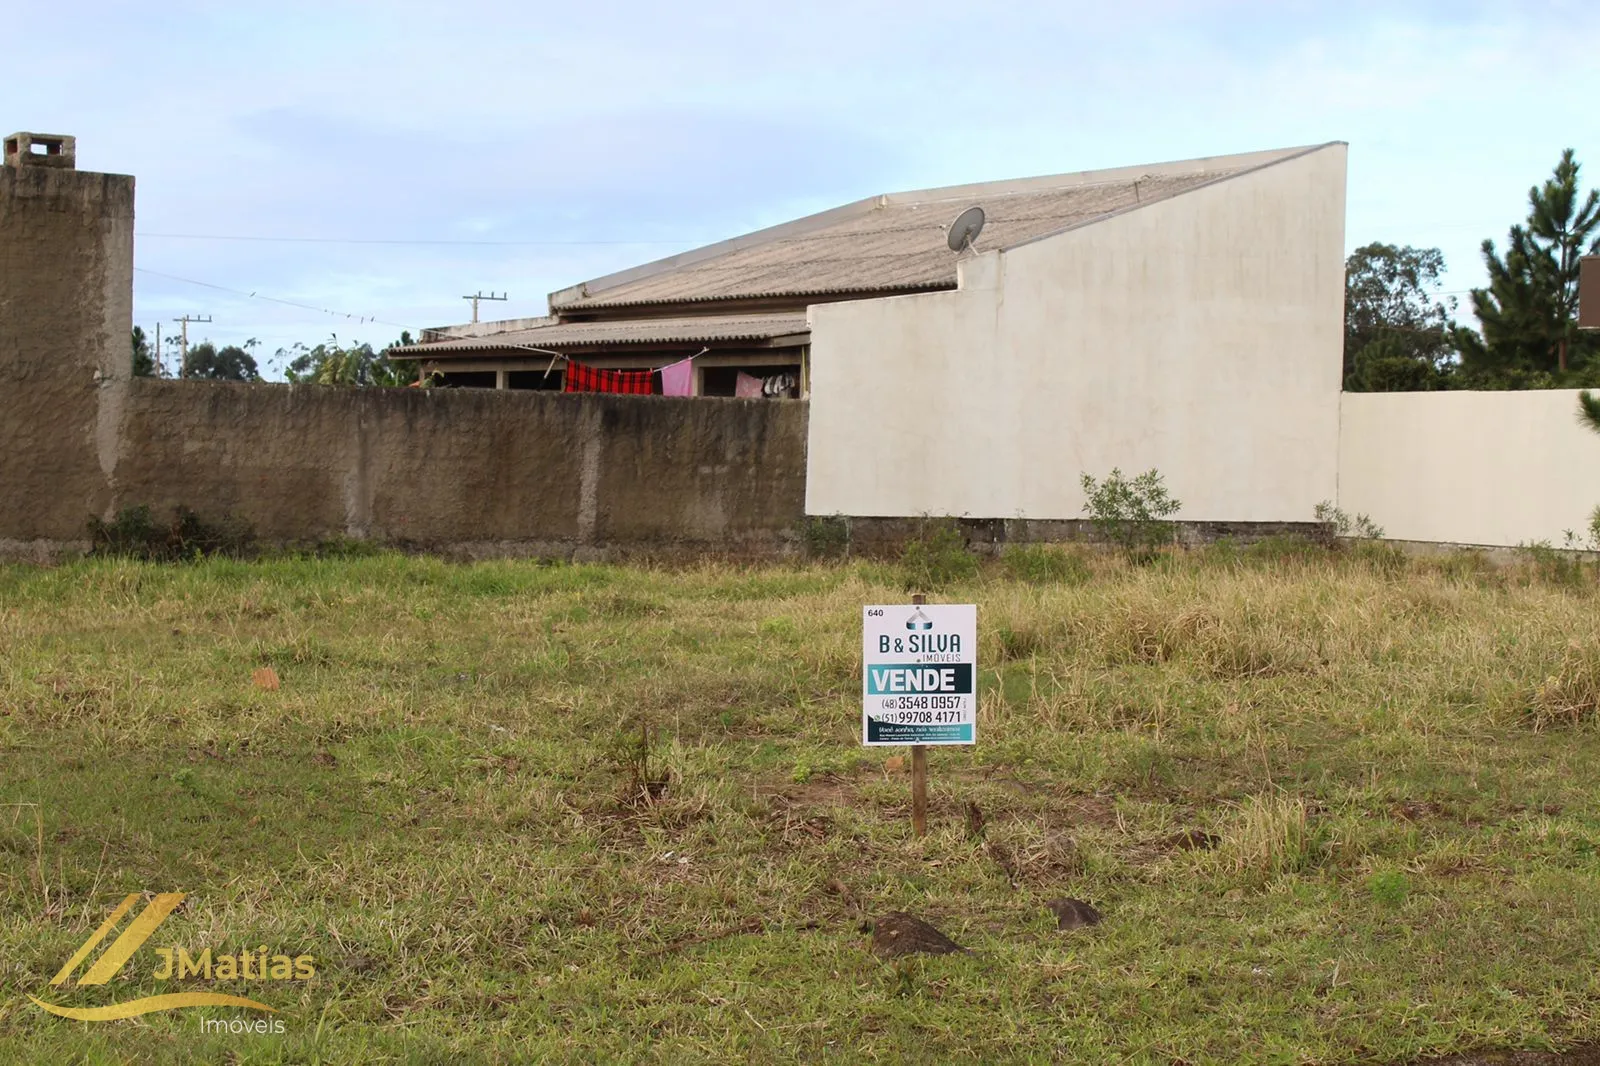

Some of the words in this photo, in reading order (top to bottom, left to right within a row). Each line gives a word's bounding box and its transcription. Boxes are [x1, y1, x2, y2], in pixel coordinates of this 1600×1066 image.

[868, 609, 884, 617] 640
[879, 634, 890, 653] B
[894, 638, 904, 653] &
[909, 634, 961, 653] SILVA
[922, 653, 961, 662] IMÓVEIS
[872, 669, 955, 691] VENDE
[882, 699, 898, 709] (48)
[899, 696, 928, 709] 3548
[931, 696, 961, 709] 0957
[882, 713, 898, 723] (51)
[899, 711, 932, 723] 99708
[935, 711, 961, 723] 4171
